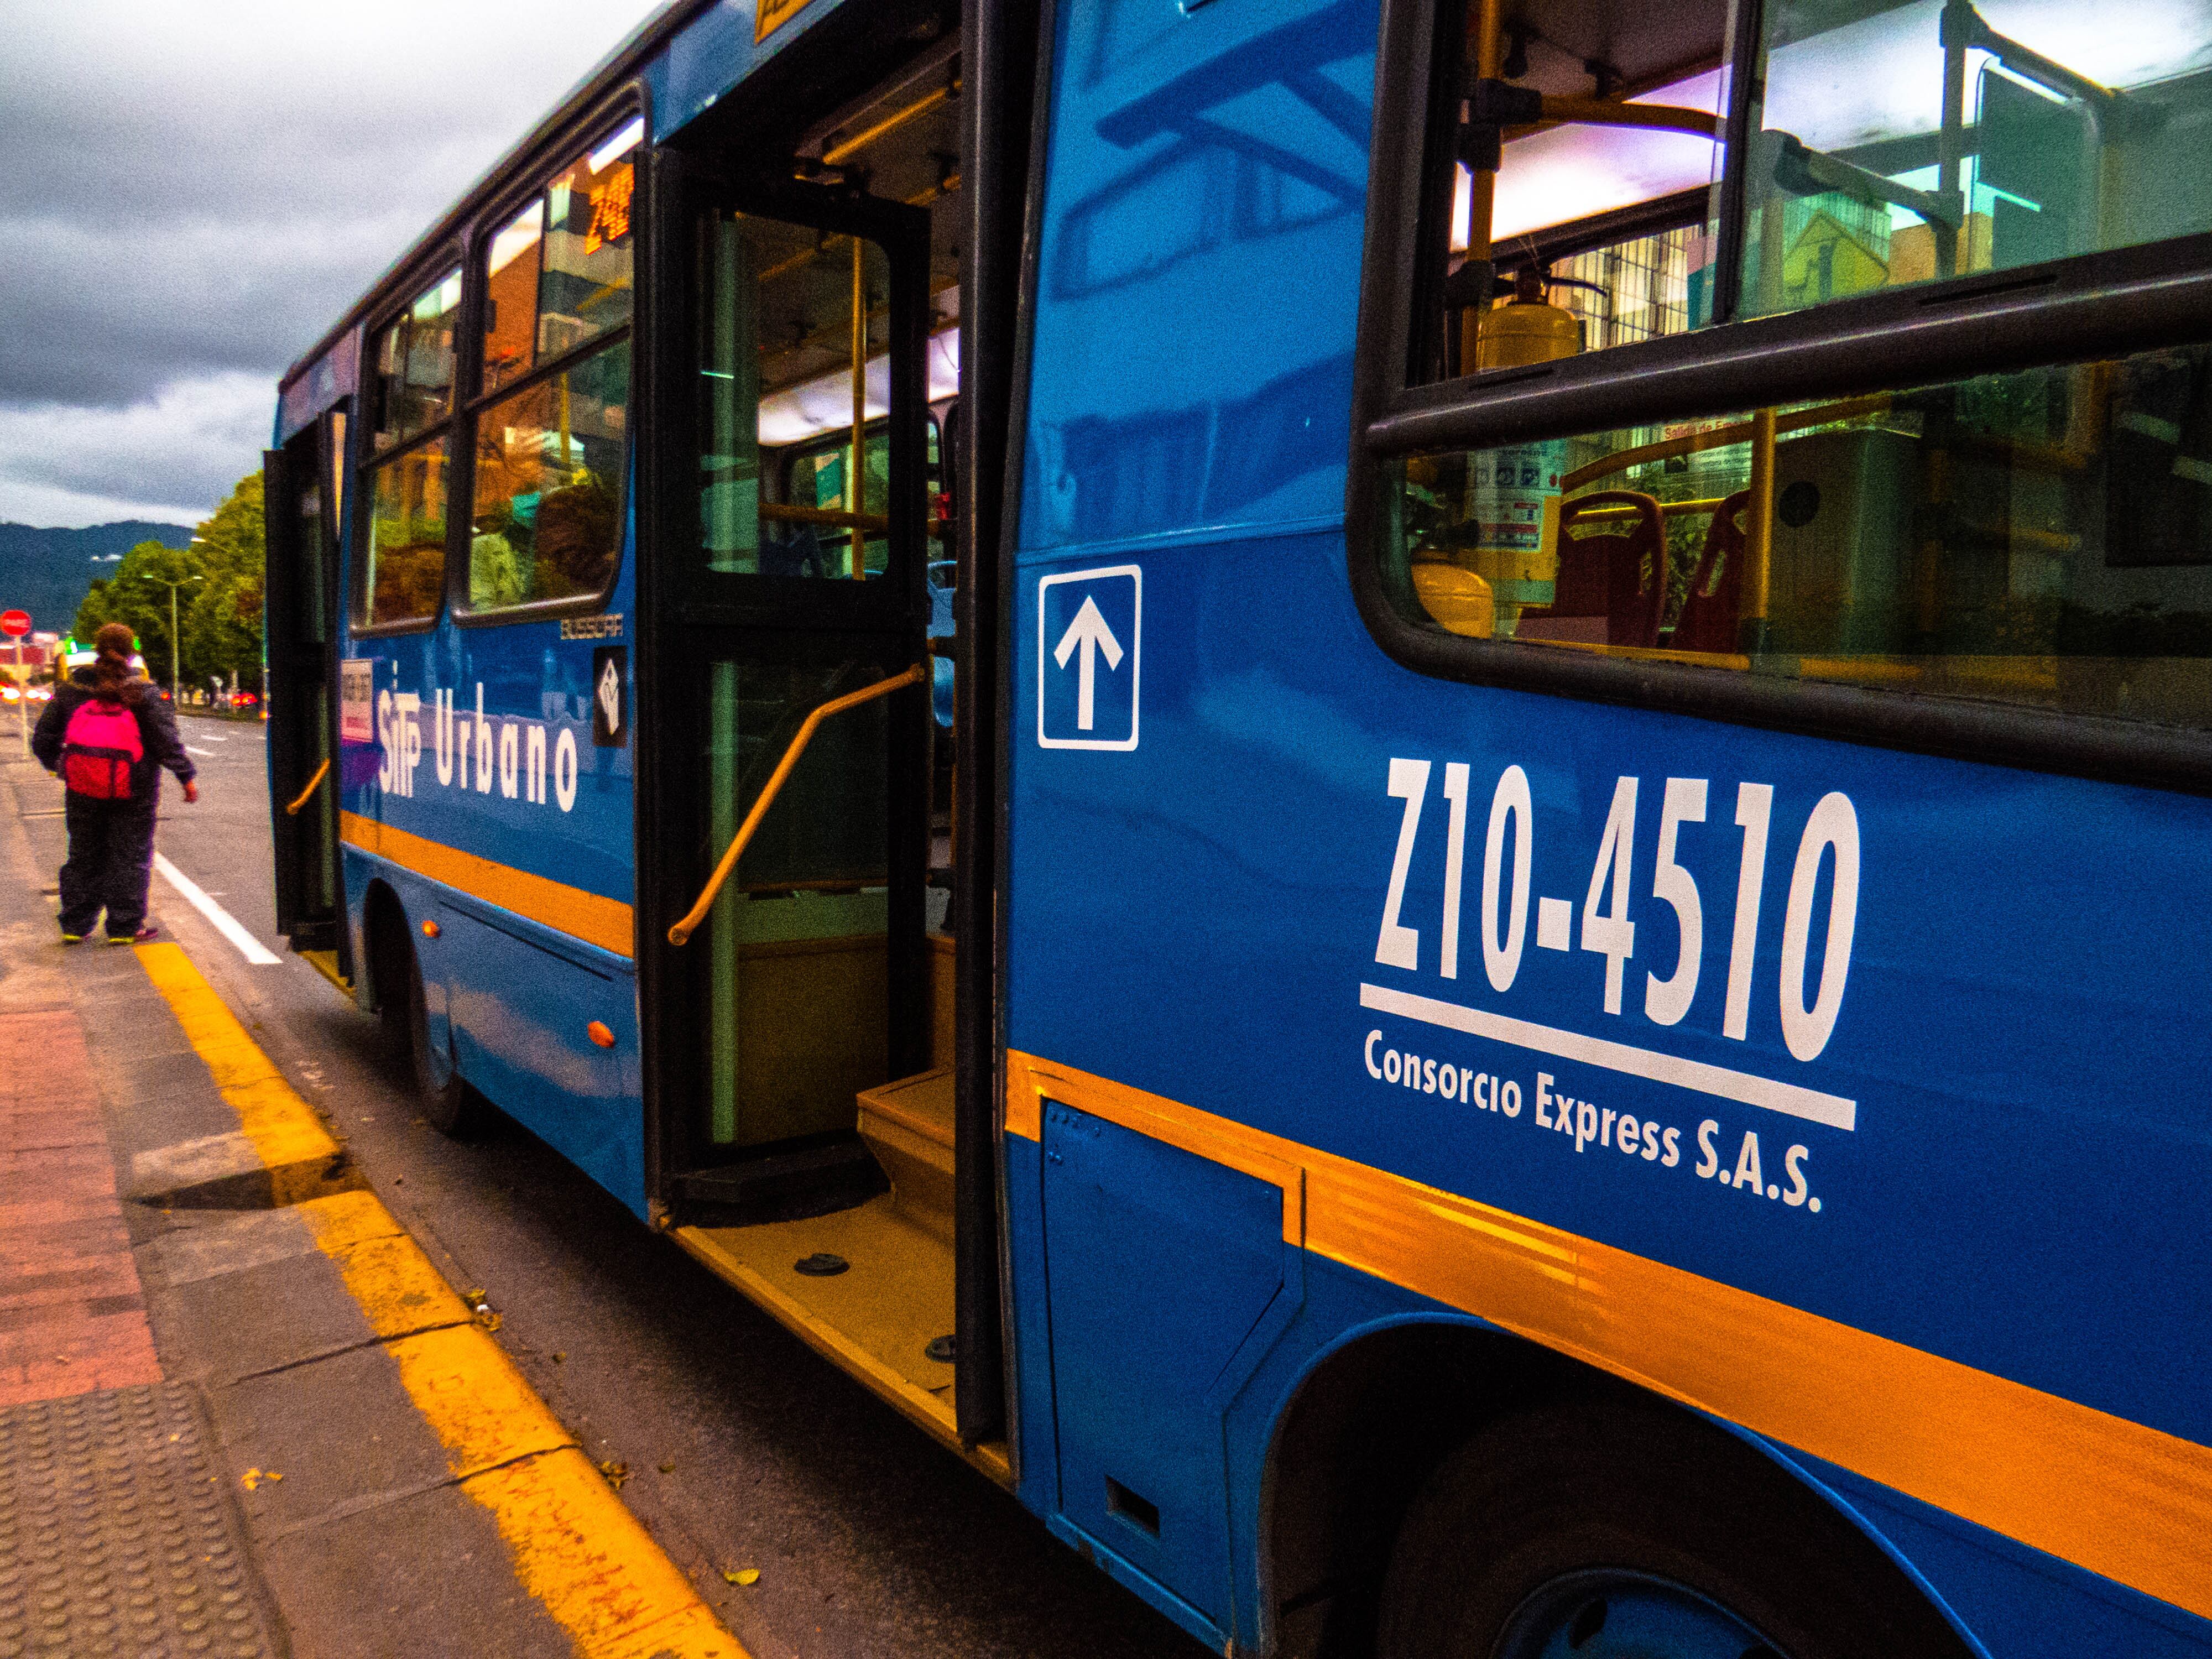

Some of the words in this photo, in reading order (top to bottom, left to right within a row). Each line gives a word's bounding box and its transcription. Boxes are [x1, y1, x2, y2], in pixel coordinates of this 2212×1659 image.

[436, 683, 578, 812] Urbano
[1375, 758, 1860, 1061] Z10-4510
[1364, 1029, 1522, 1118] Consorcio
[1535, 1072, 1681, 1167] Express
[1695, 1119, 1821, 1213] S.A.S.
